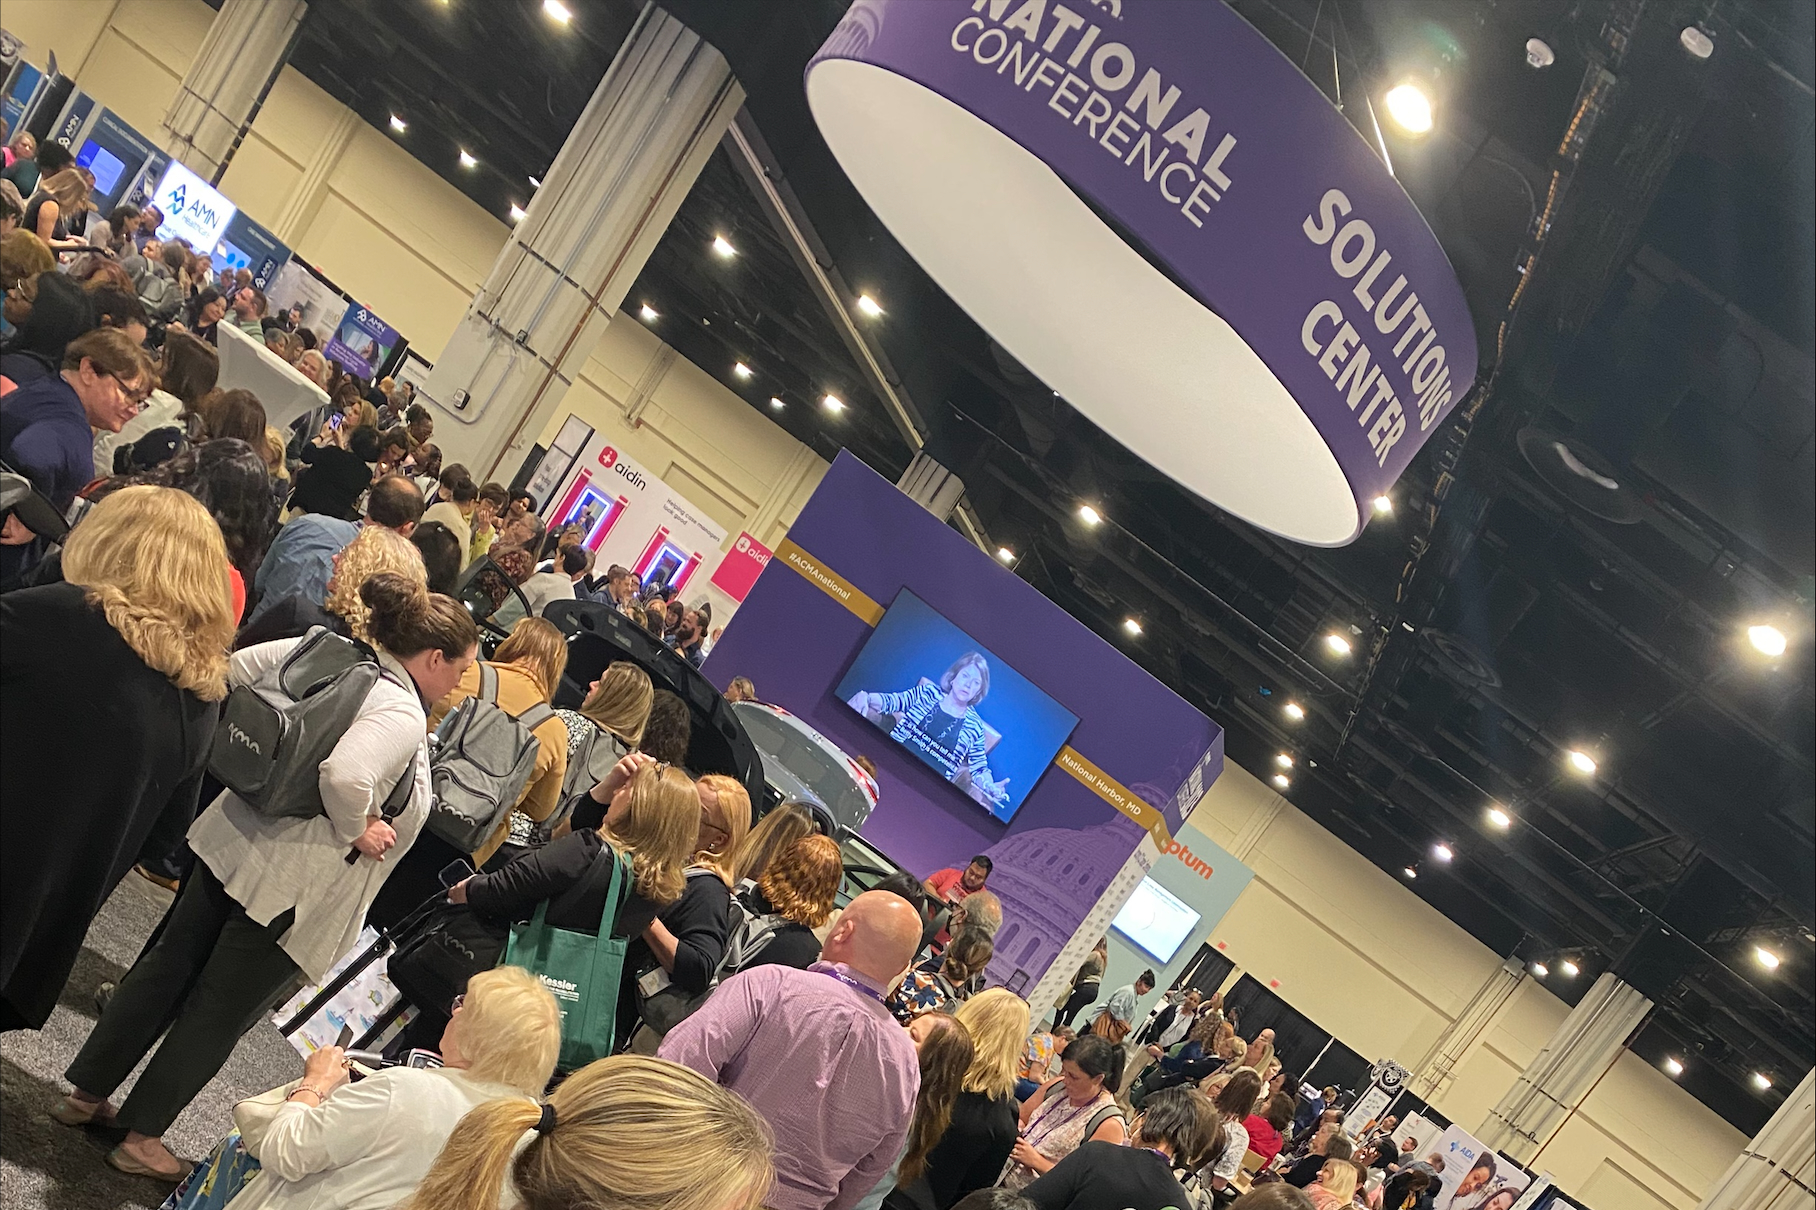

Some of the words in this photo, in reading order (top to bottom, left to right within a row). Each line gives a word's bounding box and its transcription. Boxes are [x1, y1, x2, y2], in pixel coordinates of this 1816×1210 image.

[951, 17, 1221, 228] CONFERENCE
[188, 199, 220, 229] AMN
[1302, 188, 1452, 431] SOLUTIONS
[1301, 300, 1407, 468] CENTER
[614, 459, 647, 491] aidin
[663, 504, 675, 516] look
[673, 512, 688, 526] good
[666, 498, 686, 517] Helping
[685, 511, 698, 524] case
[696, 521, 721, 543] managers
[788, 552, 851, 600] #ACMAnational
[1062, 753, 1096, 783] National
[1096, 778, 1126, 808] Harbor,
[1126, 801, 1142, 816] MD
[1162, 838, 1214, 881] ptum
[539, 974, 577, 991] Kessler
[1459, 1146, 1475, 1161] AIDA
